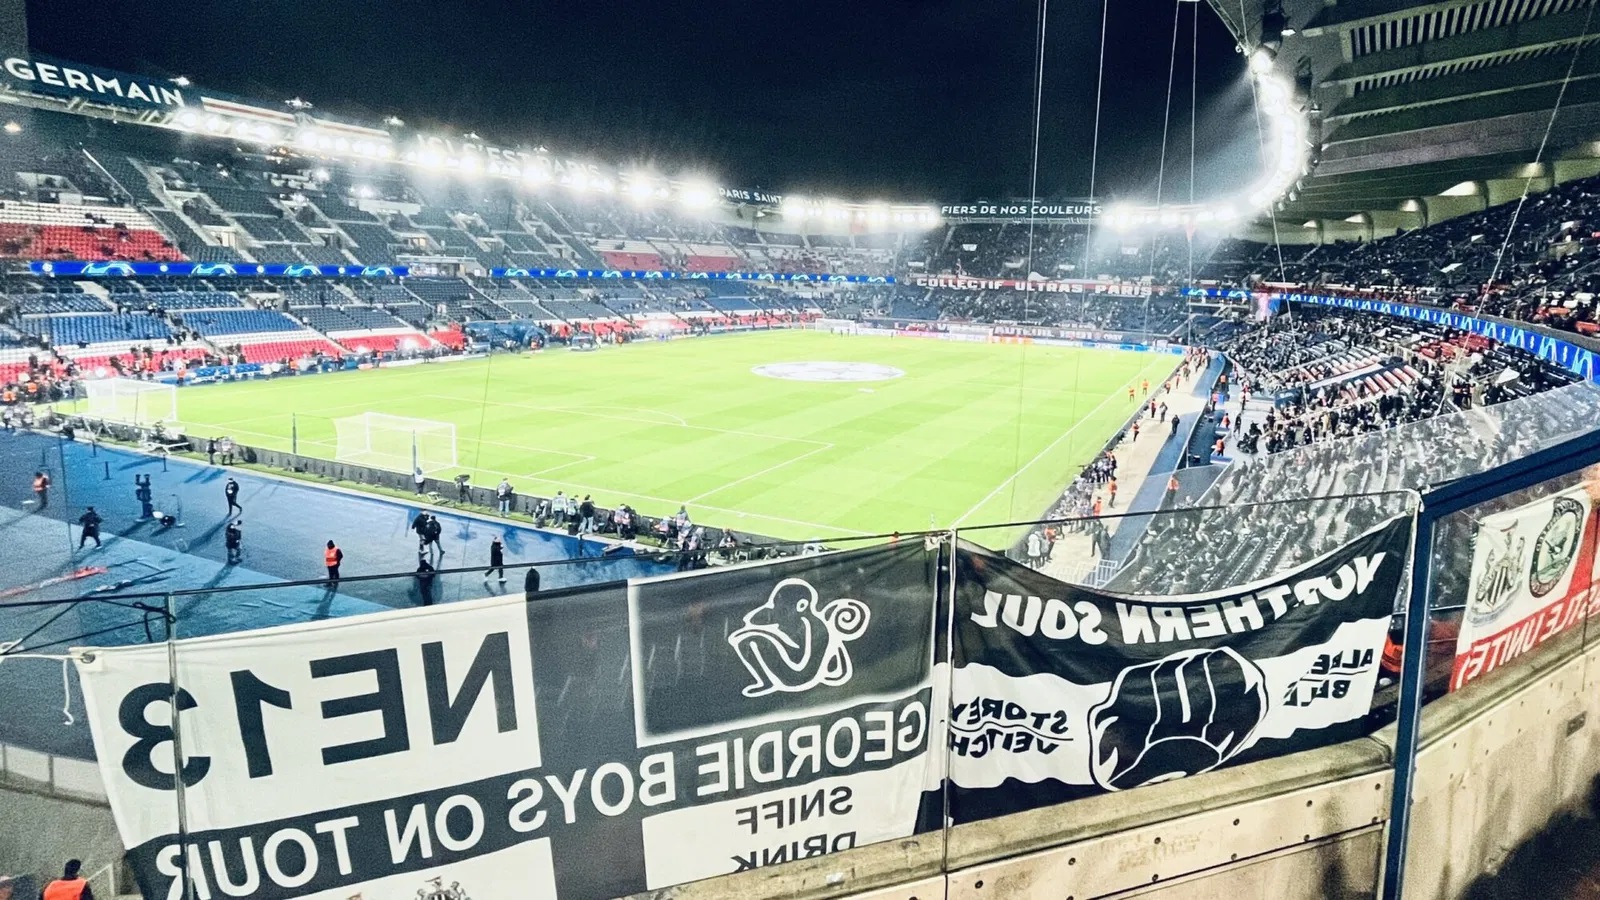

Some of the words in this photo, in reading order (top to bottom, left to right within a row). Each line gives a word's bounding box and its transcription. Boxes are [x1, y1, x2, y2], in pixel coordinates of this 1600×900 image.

[4, 57, 184, 107] GERMAIN
[719, 187, 750, 200] PARIS
[753, 191, 783, 204] SAINT
[941, 204, 978, 215] FIERS
[979, 204, 997, 215] DE
[999, 204, 1028, 215] NOS
[1030, 204, 1102, 215] COULEURS
[916, 277, 1004, 290] COLLECTIF
[1014, 281, 1083, 294] ULTRAS
[1094, 284, 1153, 297] PARIS
